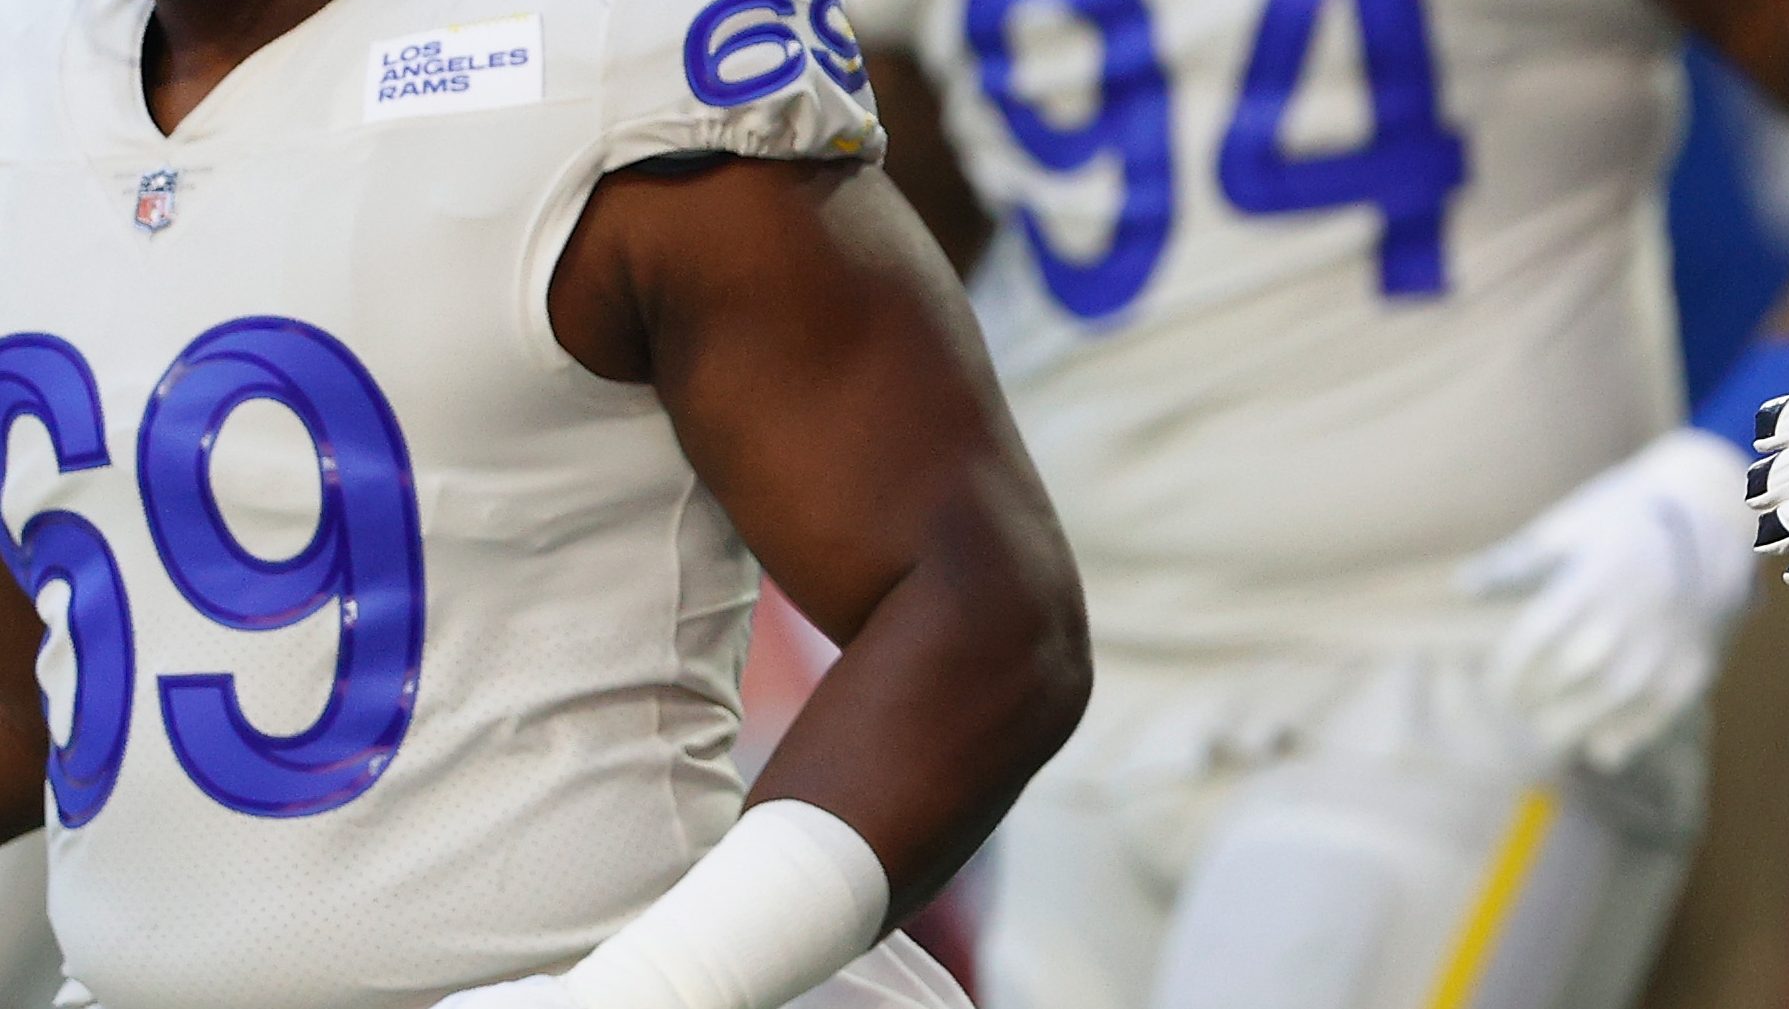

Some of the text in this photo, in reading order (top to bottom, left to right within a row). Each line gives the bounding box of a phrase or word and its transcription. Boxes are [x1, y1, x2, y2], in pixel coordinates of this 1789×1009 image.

[379, 48, 529, 83] ANGELES
[383, 41, 442, 66] LOS
[378, 75, 470, 102] RAMS
[0, 314, 426, 828] 69
